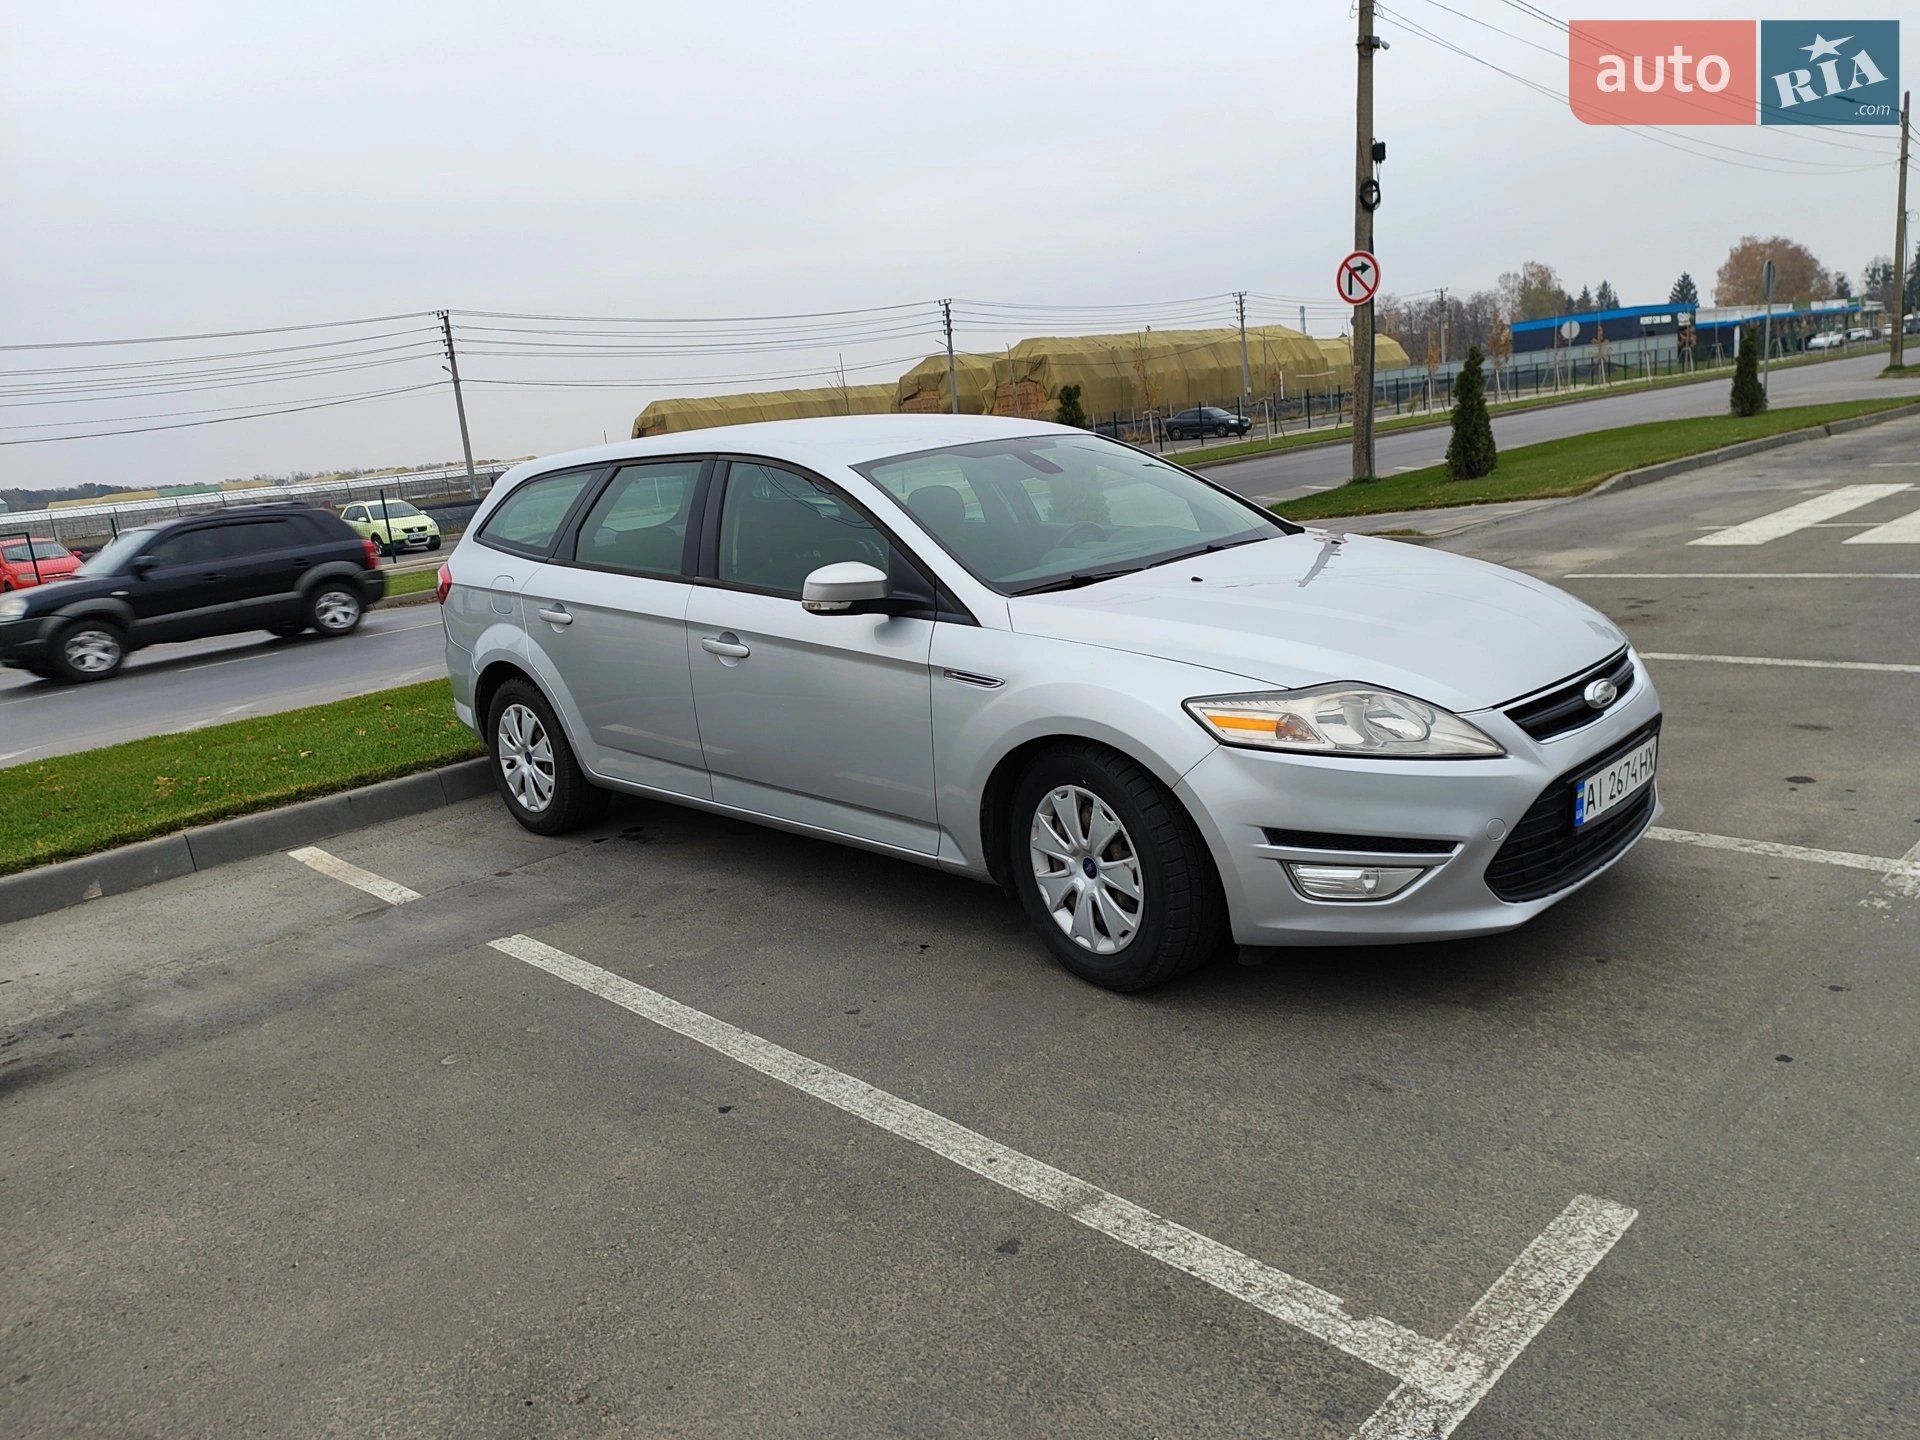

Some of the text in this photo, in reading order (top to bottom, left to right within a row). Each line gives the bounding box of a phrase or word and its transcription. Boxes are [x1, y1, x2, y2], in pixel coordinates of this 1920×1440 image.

[1585, 743, 1655, 815] AI 2674 HX
